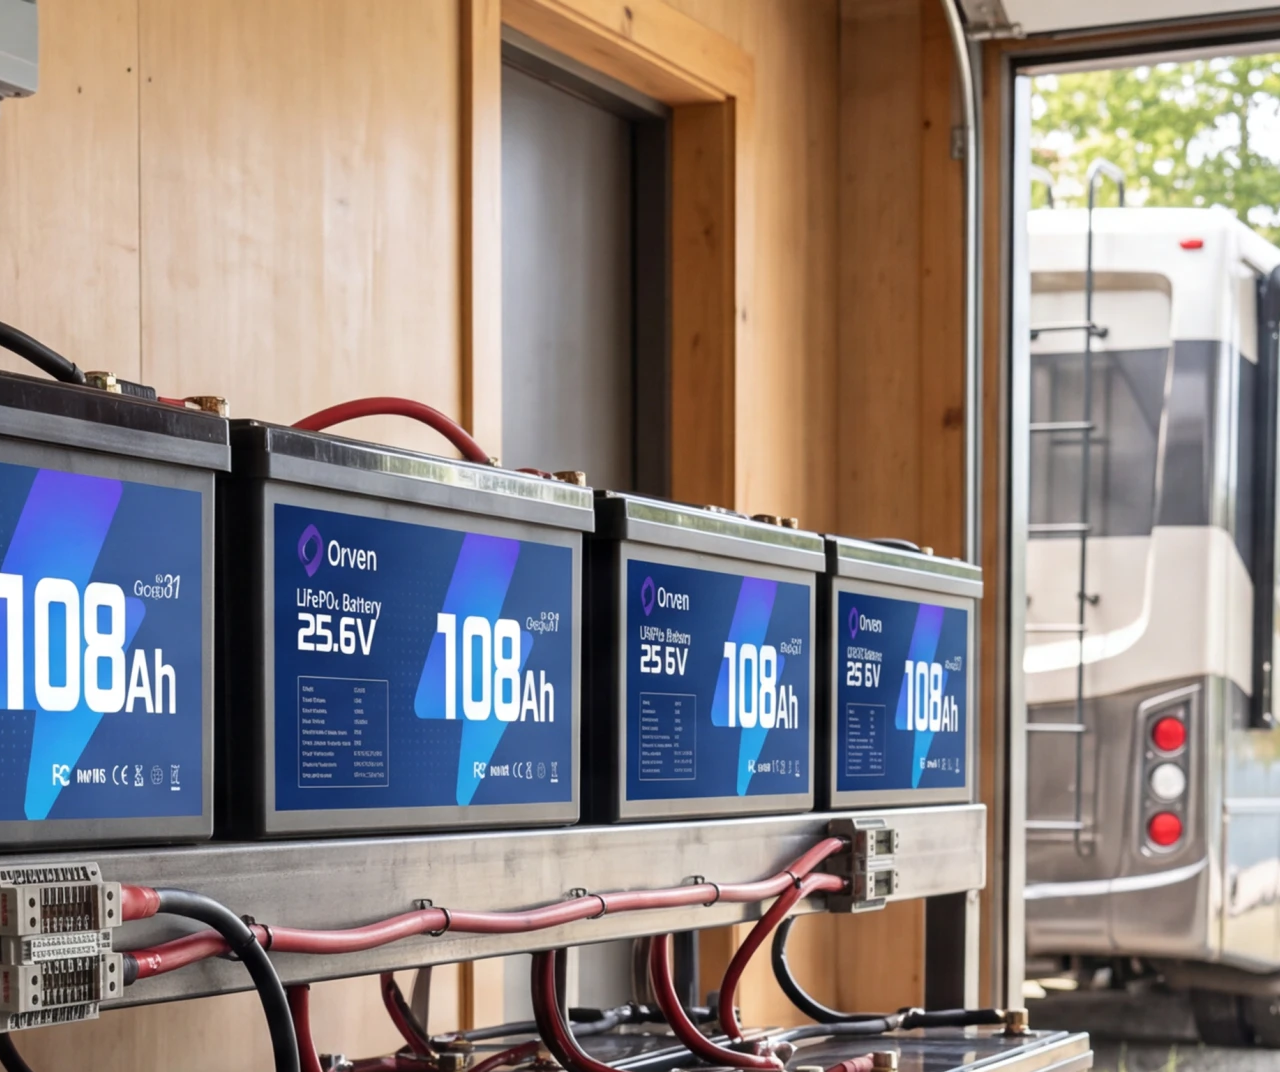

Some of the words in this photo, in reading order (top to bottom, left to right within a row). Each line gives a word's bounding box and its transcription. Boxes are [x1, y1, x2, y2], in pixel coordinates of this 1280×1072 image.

[328, 539, 378, 571] Orven
[342, 593, 381, 620] Battery
[657, 586, 690, 611] Orven
[297, 612, 377, 655] 25.6V
[437, 612, 555, 722] 108Ah
[723, 641, 798, 729] 108Ah
[904, 660, 959, 732] 108Ah
